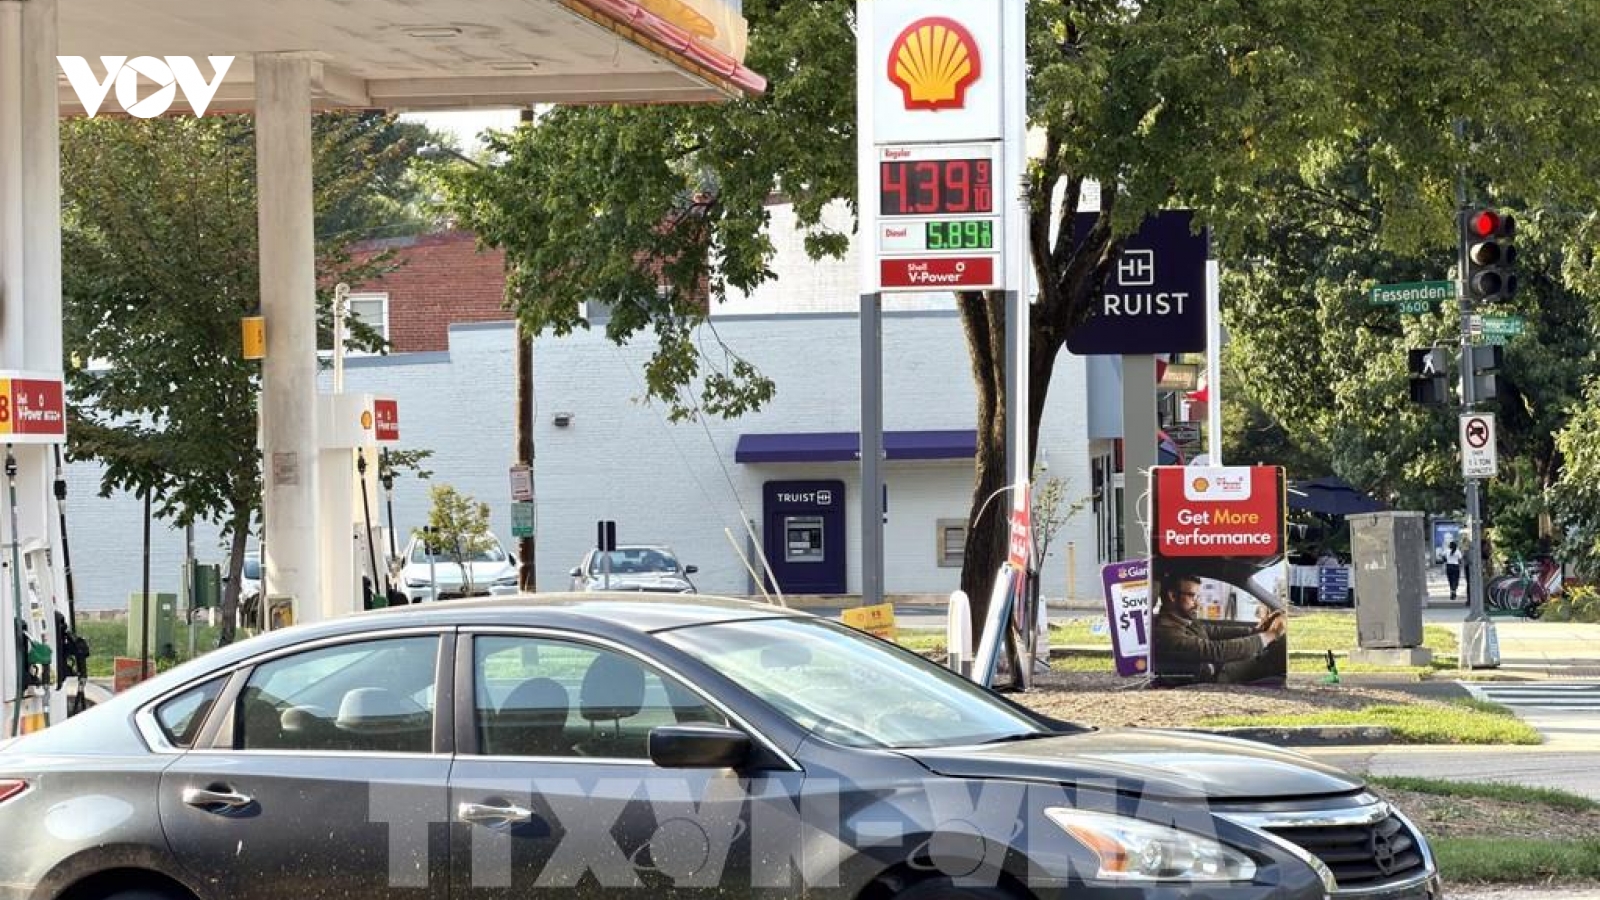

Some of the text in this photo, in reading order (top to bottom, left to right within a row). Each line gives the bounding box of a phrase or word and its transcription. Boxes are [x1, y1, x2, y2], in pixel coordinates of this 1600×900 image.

[885, 148, 911, 159] Regular
[882, 161, 970, 213] 4.39
[885, 228, 907, 238] Diesel
[929, 222, 978, 248] 5.89
[908, 263, 928, 271] Shell
[908, 272, 962, 283] V-Power
[1373, 285, 1446, 302] Fessenden
[1092, 293, 1188, 315] RUIST
[1400, 302, 1429, 313] 3600
[777, 493, 815, 502] TRUIST
[1178, 509, 1259, 525] Get More
[1166, 529, 1271, 546] Performance
